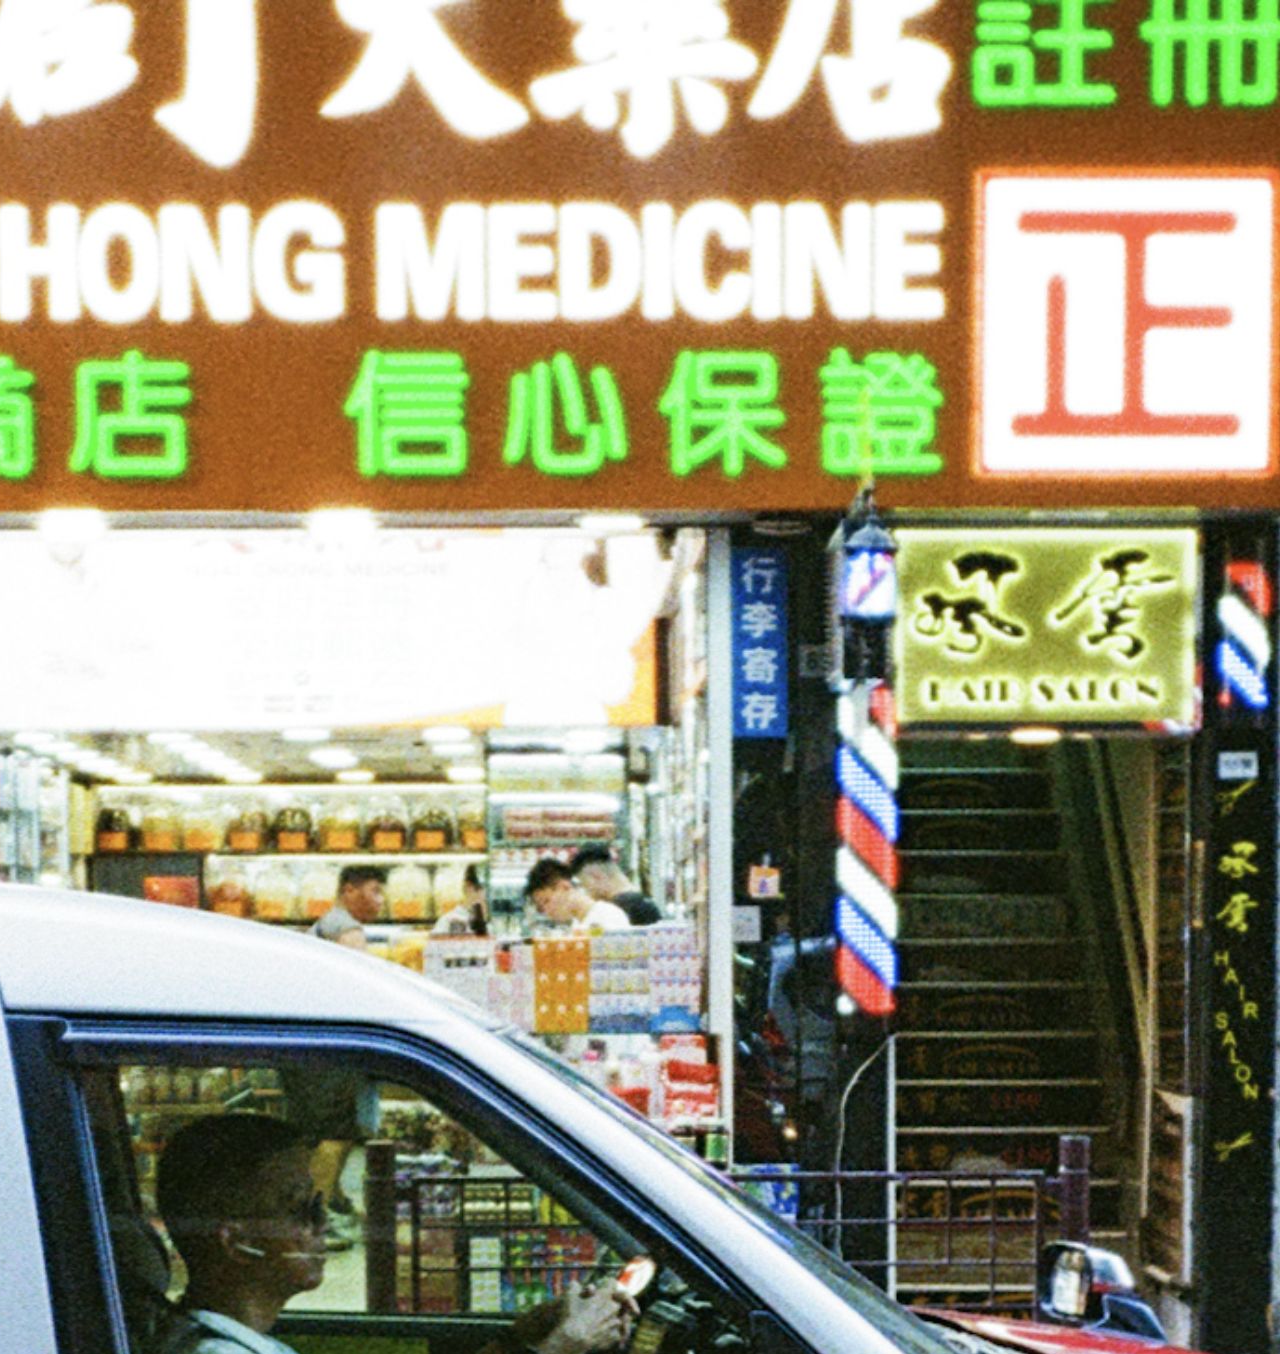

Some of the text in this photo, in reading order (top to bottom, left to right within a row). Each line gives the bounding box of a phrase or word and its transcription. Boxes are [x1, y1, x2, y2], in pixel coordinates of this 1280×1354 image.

[374, 201, 947, 324] MEDICINE
[1011, 210, 1241, 438] 正
[343, 346, 945, 479] 信心保證
[740, 557, 780, 731] 行李寄存
[1215, 950, 1259, 1019] HAIR
[1215, 1012, 1259, 1100] SALON
